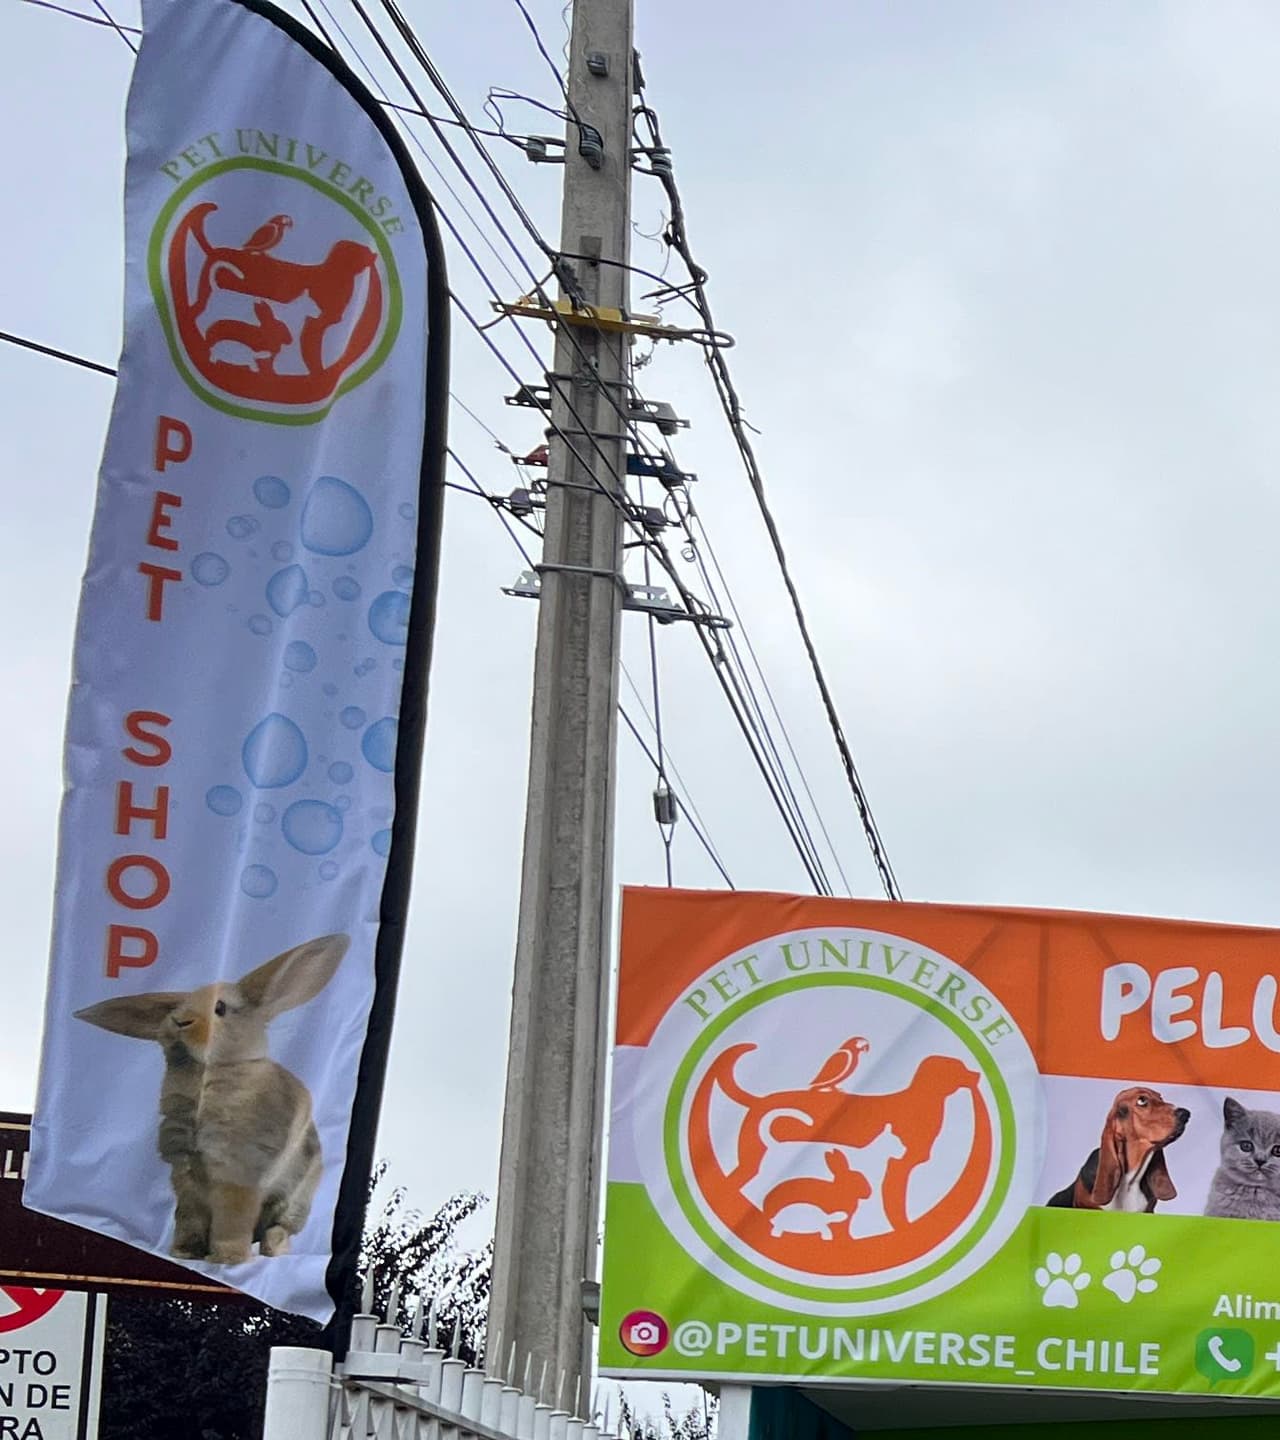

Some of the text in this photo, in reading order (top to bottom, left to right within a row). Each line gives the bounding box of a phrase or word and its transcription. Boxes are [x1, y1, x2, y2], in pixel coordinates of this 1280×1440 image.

[160, 128, 405, 238] PET UNIVERSE
[138, 414, 193, 622] PET
[106, 710, 173, 979] SHOP
[681, 937, 1016, 1048] PET UNIVERSE
[26, 1383, 71, 1410] DE
[673, 1319, 1161, 1376] @PETUNIVERSE_CHILE
